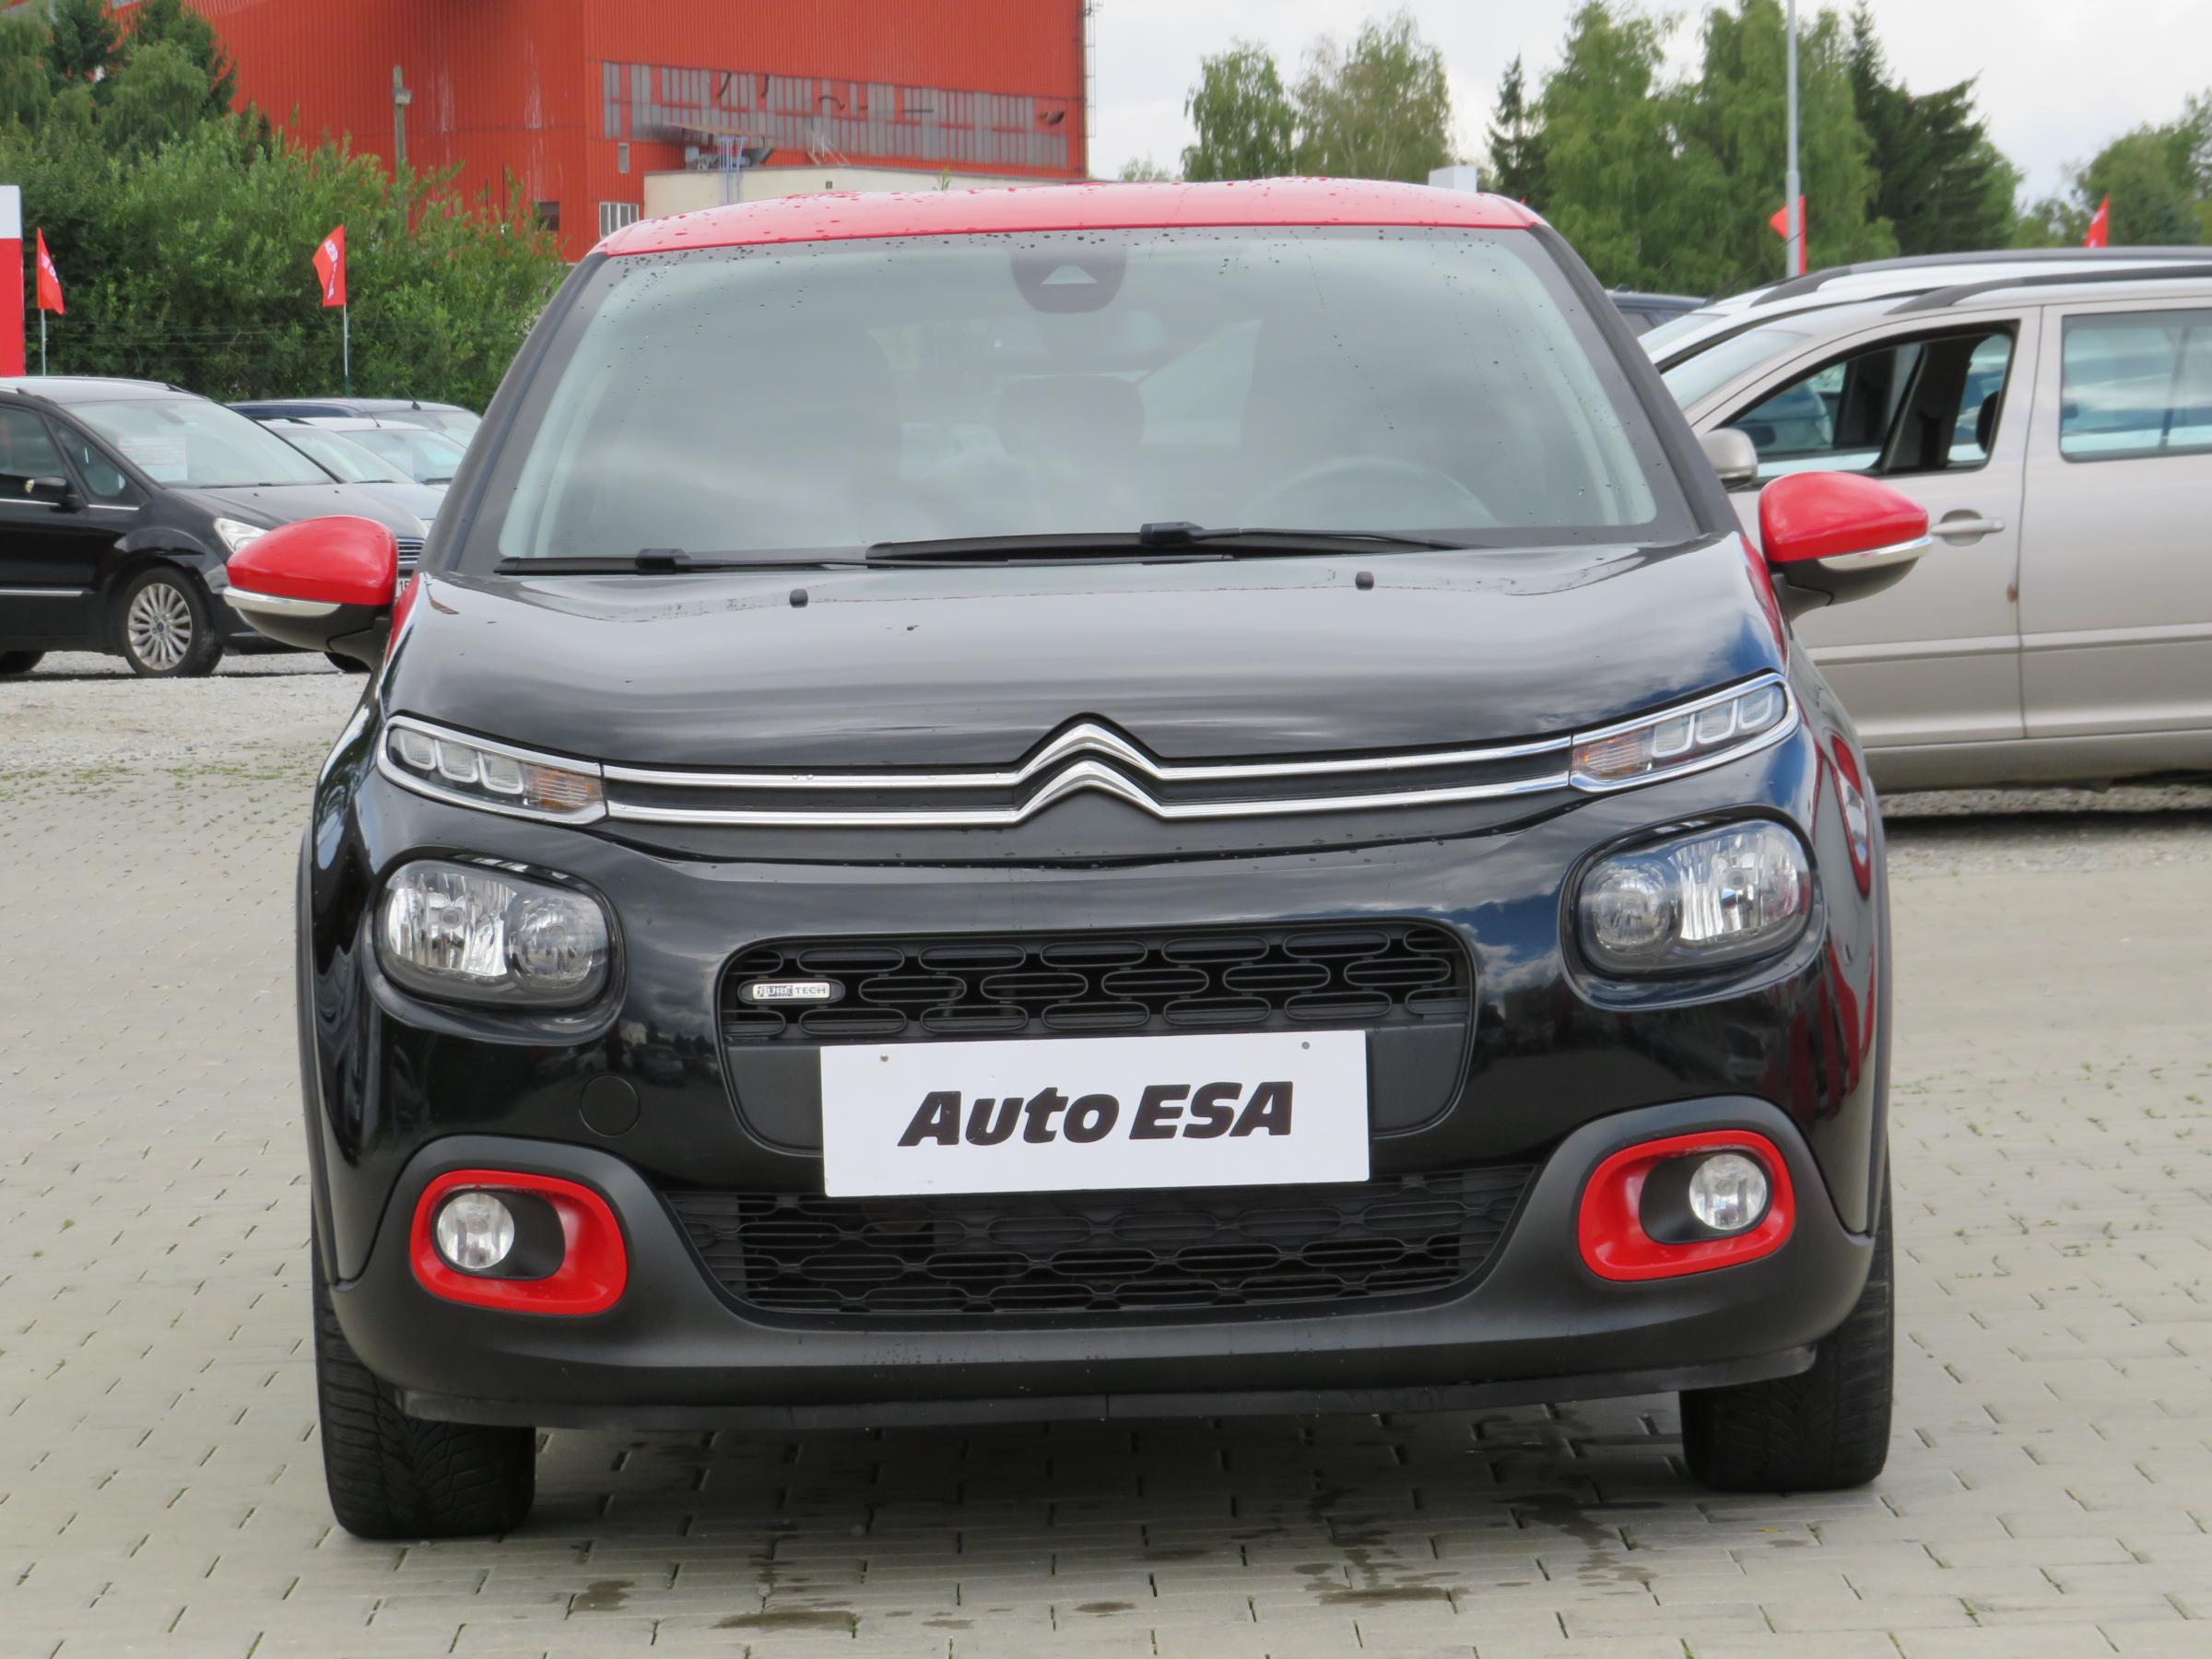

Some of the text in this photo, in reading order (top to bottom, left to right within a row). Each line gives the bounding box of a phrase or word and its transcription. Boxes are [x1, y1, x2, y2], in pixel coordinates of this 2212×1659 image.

[794, 986, 826, 994] TECH
[897, 1081, 1293, 1147] Auto ESA
